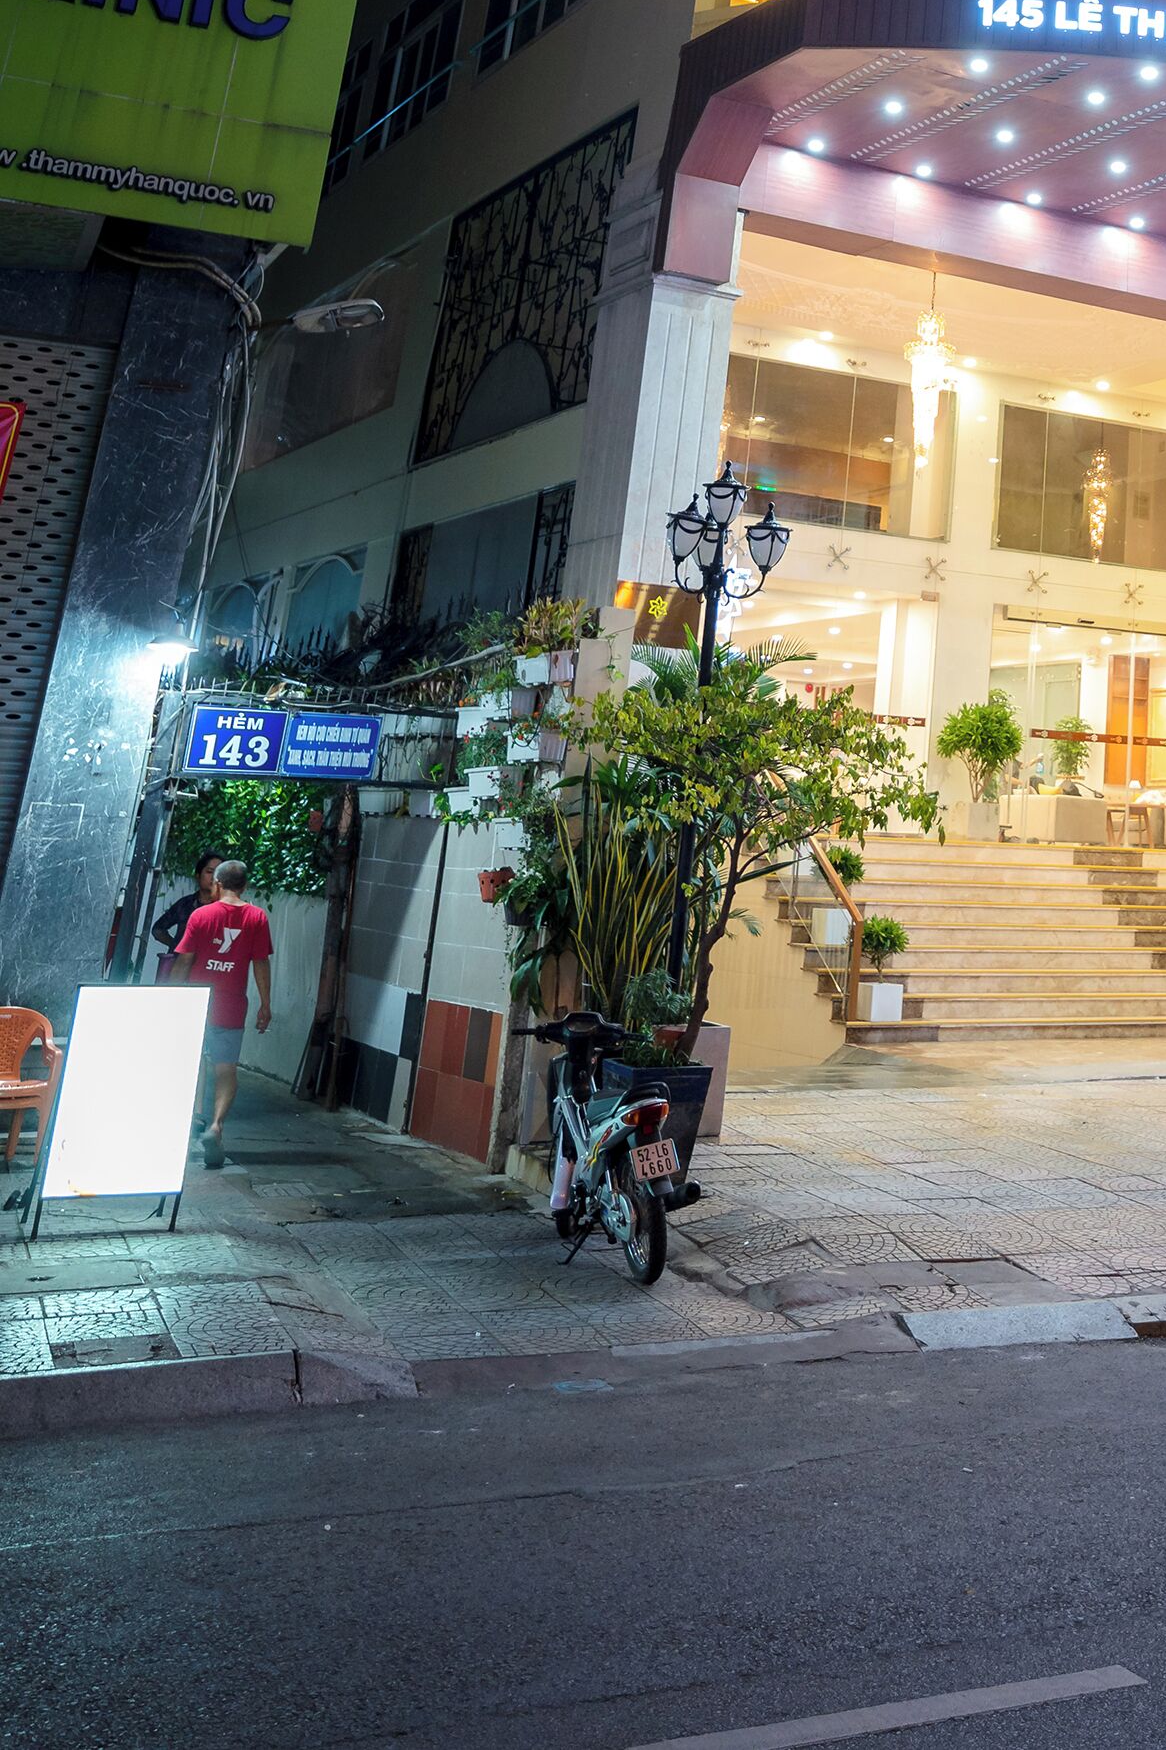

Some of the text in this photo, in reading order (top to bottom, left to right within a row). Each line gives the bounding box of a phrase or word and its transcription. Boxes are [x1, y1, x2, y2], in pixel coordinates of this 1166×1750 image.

[217, 713, 264, 731] HẺM
[198, 734, 270, 768] 143
[206, 959, 235, 972] STAFF
[636, 1143, 669, 1163] 52-L6
[641, 1157, 673, 1178] 4660
